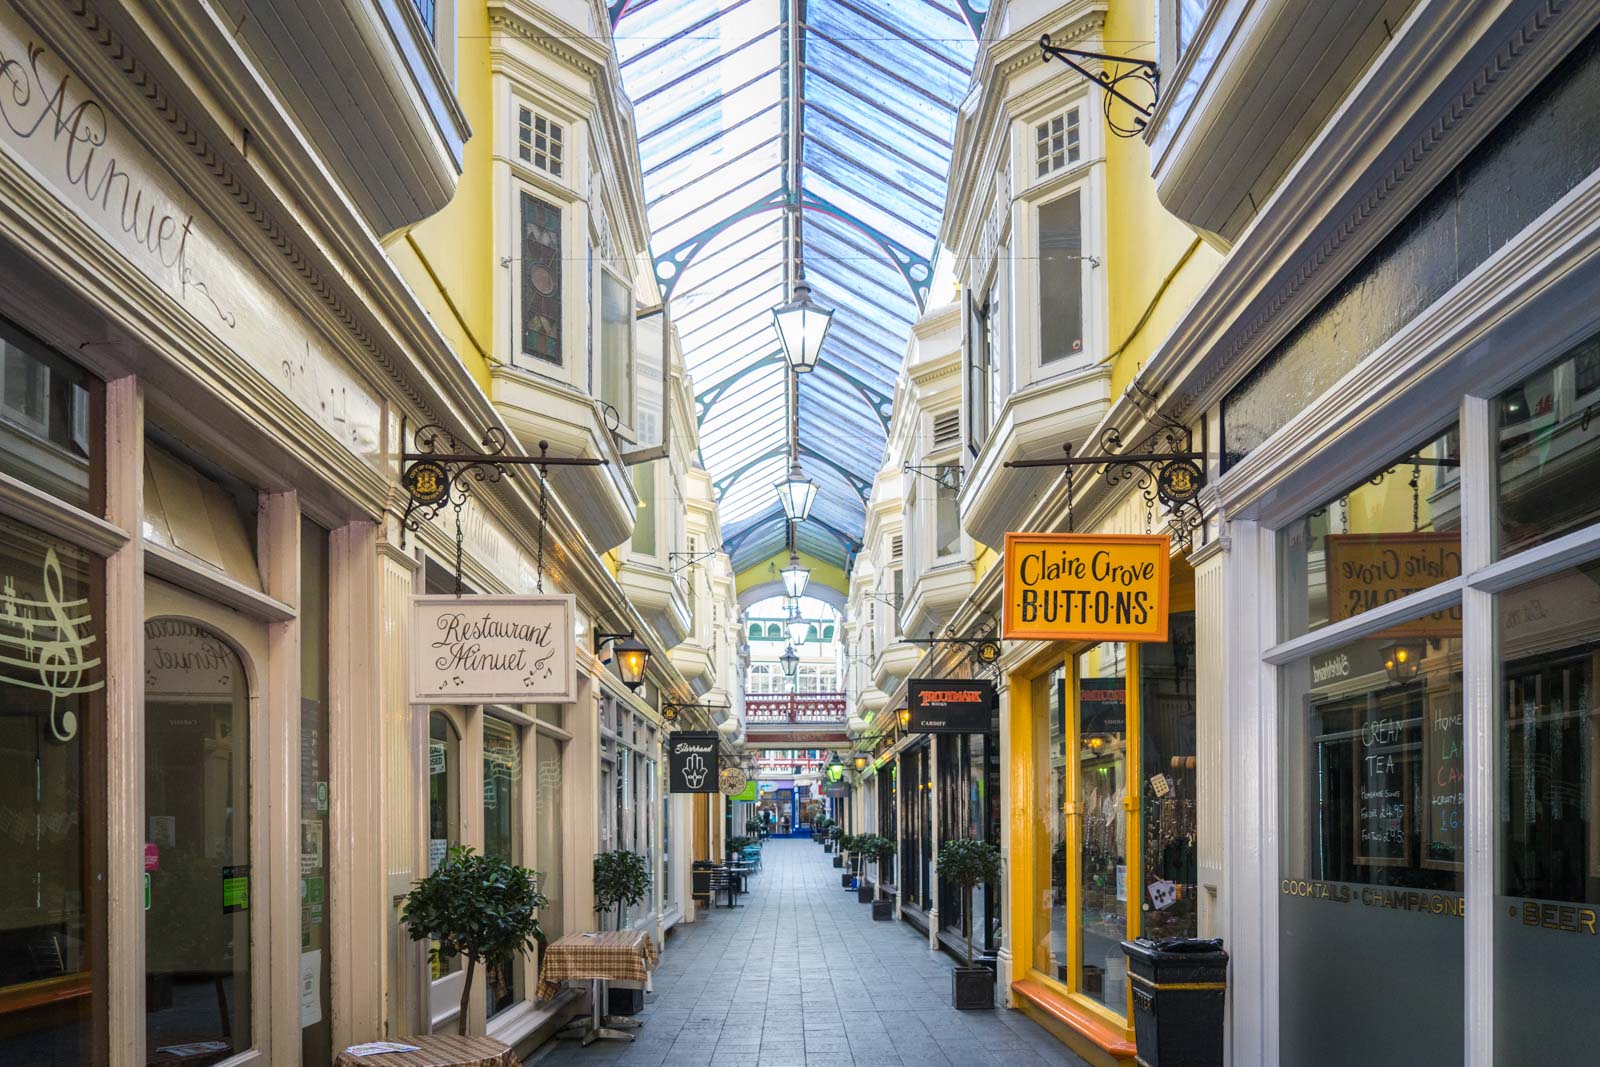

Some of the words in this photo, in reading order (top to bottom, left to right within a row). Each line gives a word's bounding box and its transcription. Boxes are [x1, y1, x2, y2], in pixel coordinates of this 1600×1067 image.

[0, 42, 204, 304] Minuet
[1020, 550, 1086, 586] Claire
[1091, 550, 1154, 586] Grove
[432, 613, 552, 648] Restaurant
[436, 642, 526, 671] Minuet
[674, 743, 713, 754] Silverhand
[1365, 754, 1395, 777] TEA
[1281, 879, 1350, 903] COCKTAILS
[1522, 900, 1598, 935] BEER
